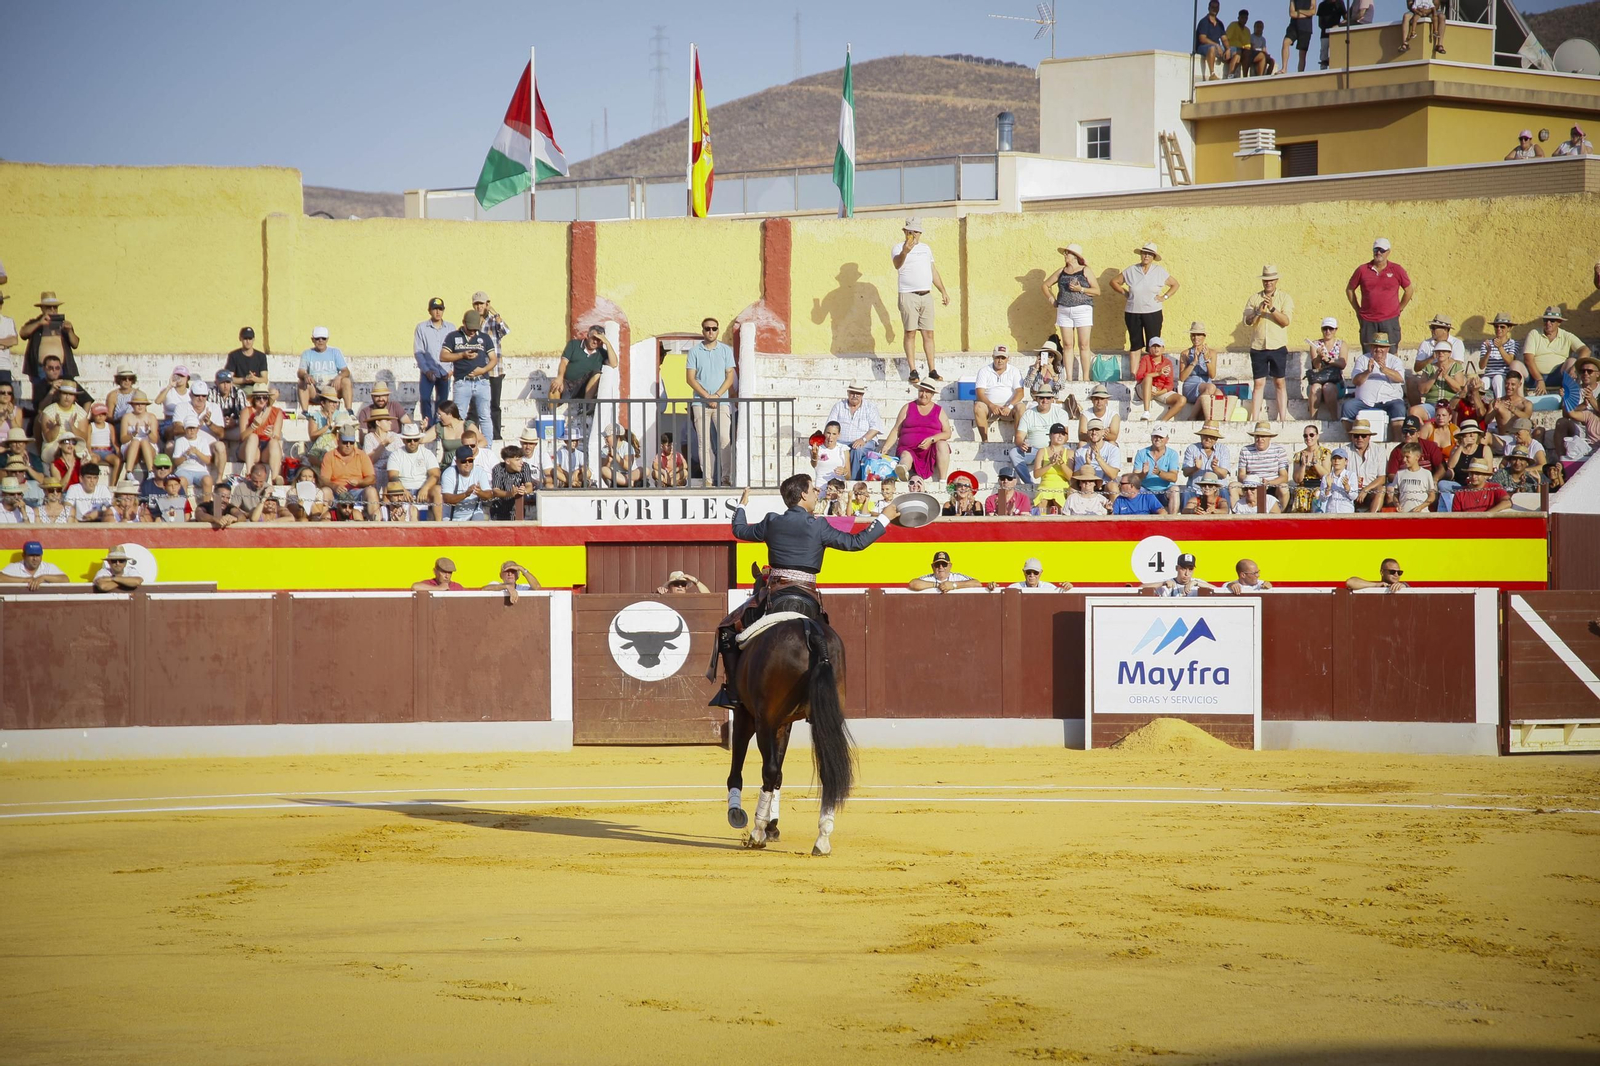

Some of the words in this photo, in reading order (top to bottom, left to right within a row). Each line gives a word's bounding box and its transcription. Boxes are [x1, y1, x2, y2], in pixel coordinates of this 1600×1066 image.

[590, 498, 739, 520] TORILES
[1148, 551, 1165, 573] 4
[1117, 660, 1230, 692] Mayfra
[1128, 695, 1161, 704] OBRAS
[1163, 695, 1170, 704] Y
[1170, 695, 1219, 705] SERVICIOS
